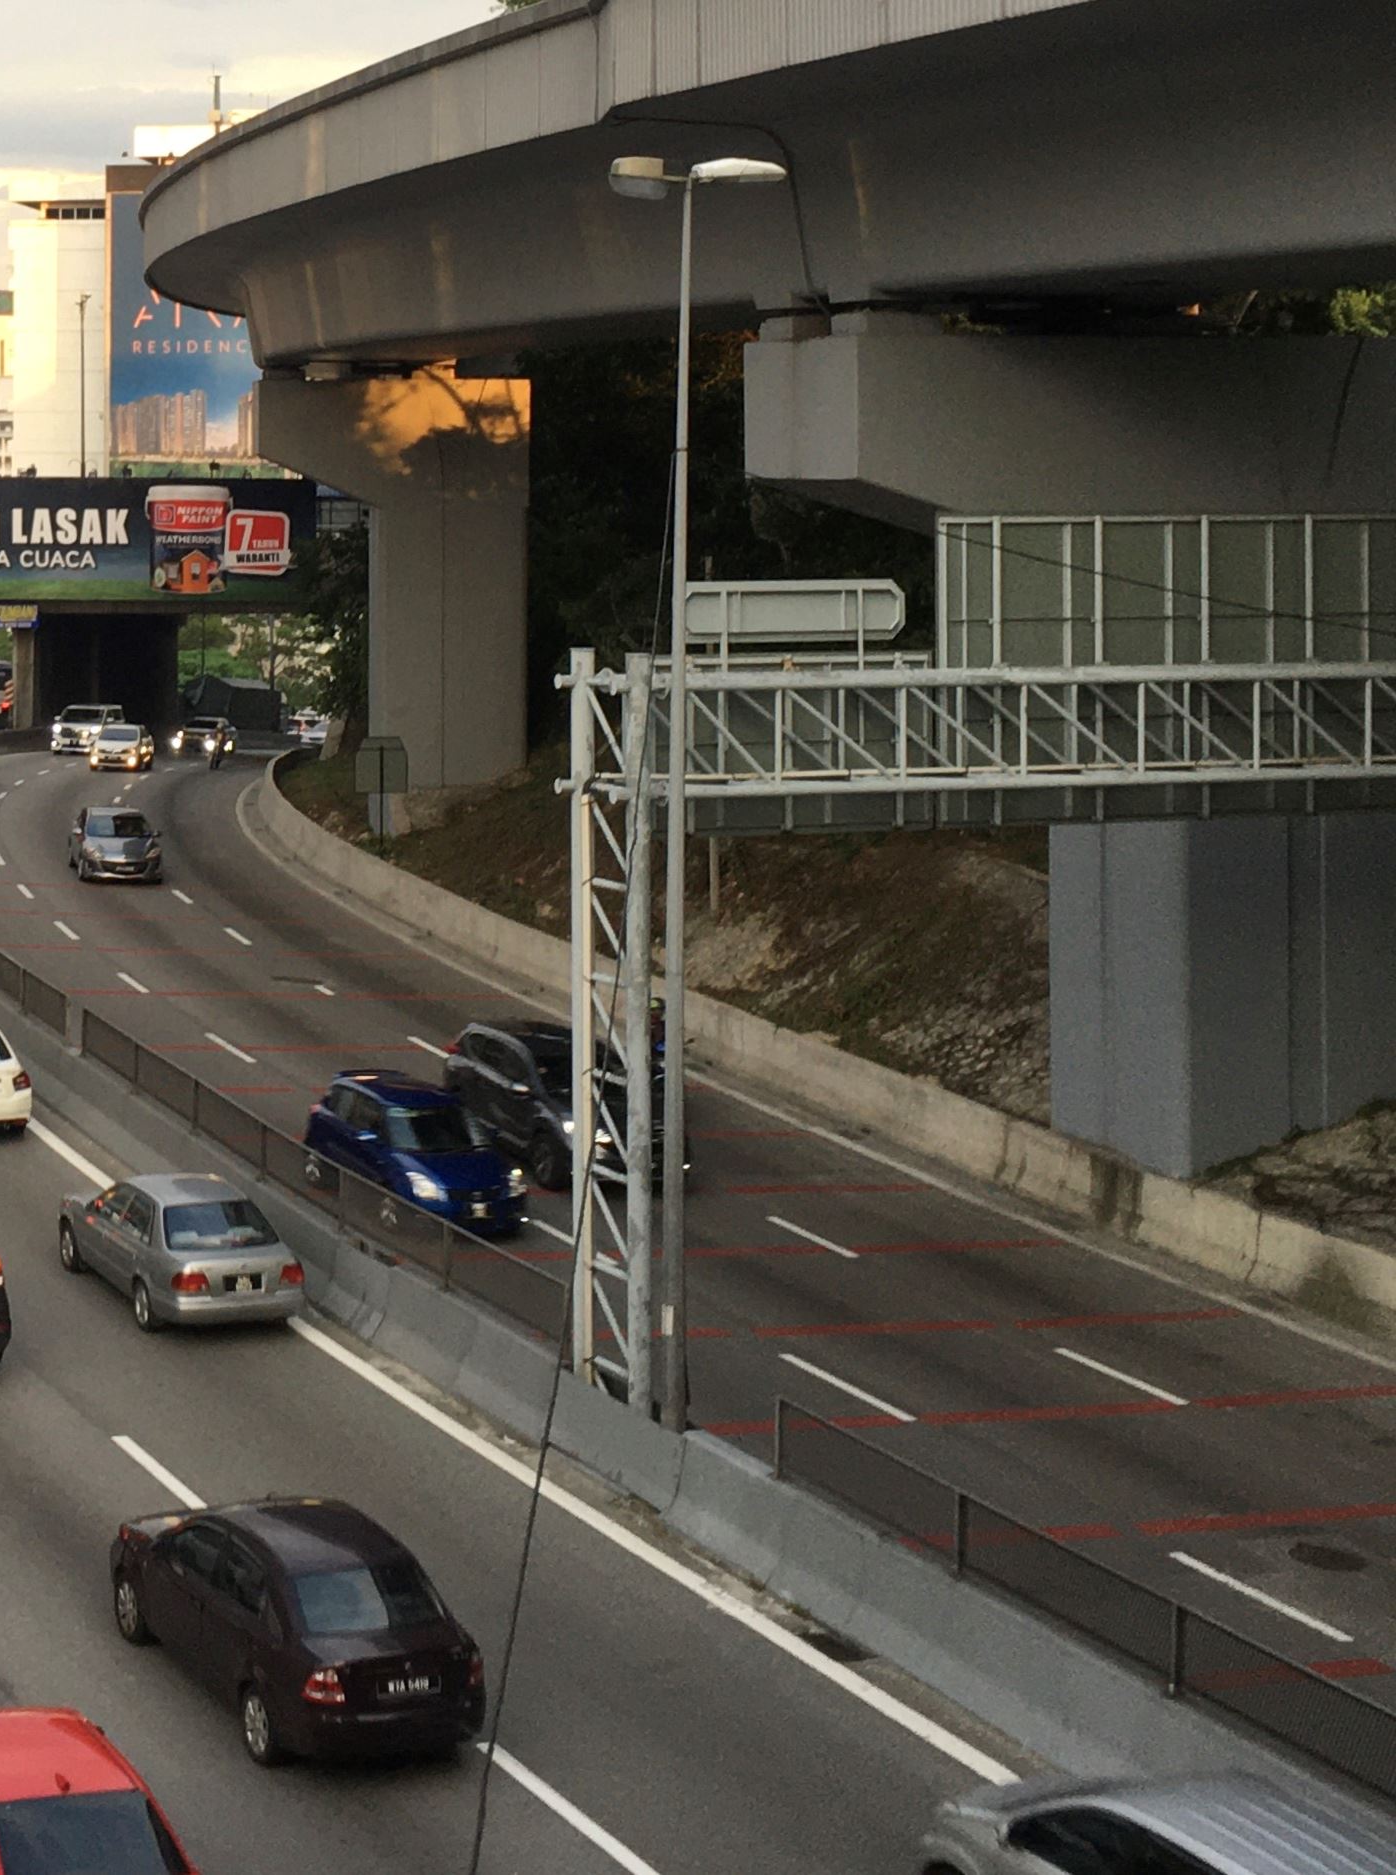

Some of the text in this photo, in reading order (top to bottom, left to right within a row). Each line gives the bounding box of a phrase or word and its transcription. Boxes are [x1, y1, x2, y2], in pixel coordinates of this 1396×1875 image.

[132, 339, 249, 354] RESIDENC
[177, 506, 223, 514] NIPPON
[11, 508, 129, 544] LASAK
[181, 515, 217, 524] PAINT
[236, 518, 254, 551] 7
[19, 550, 96, 568] CUACA
